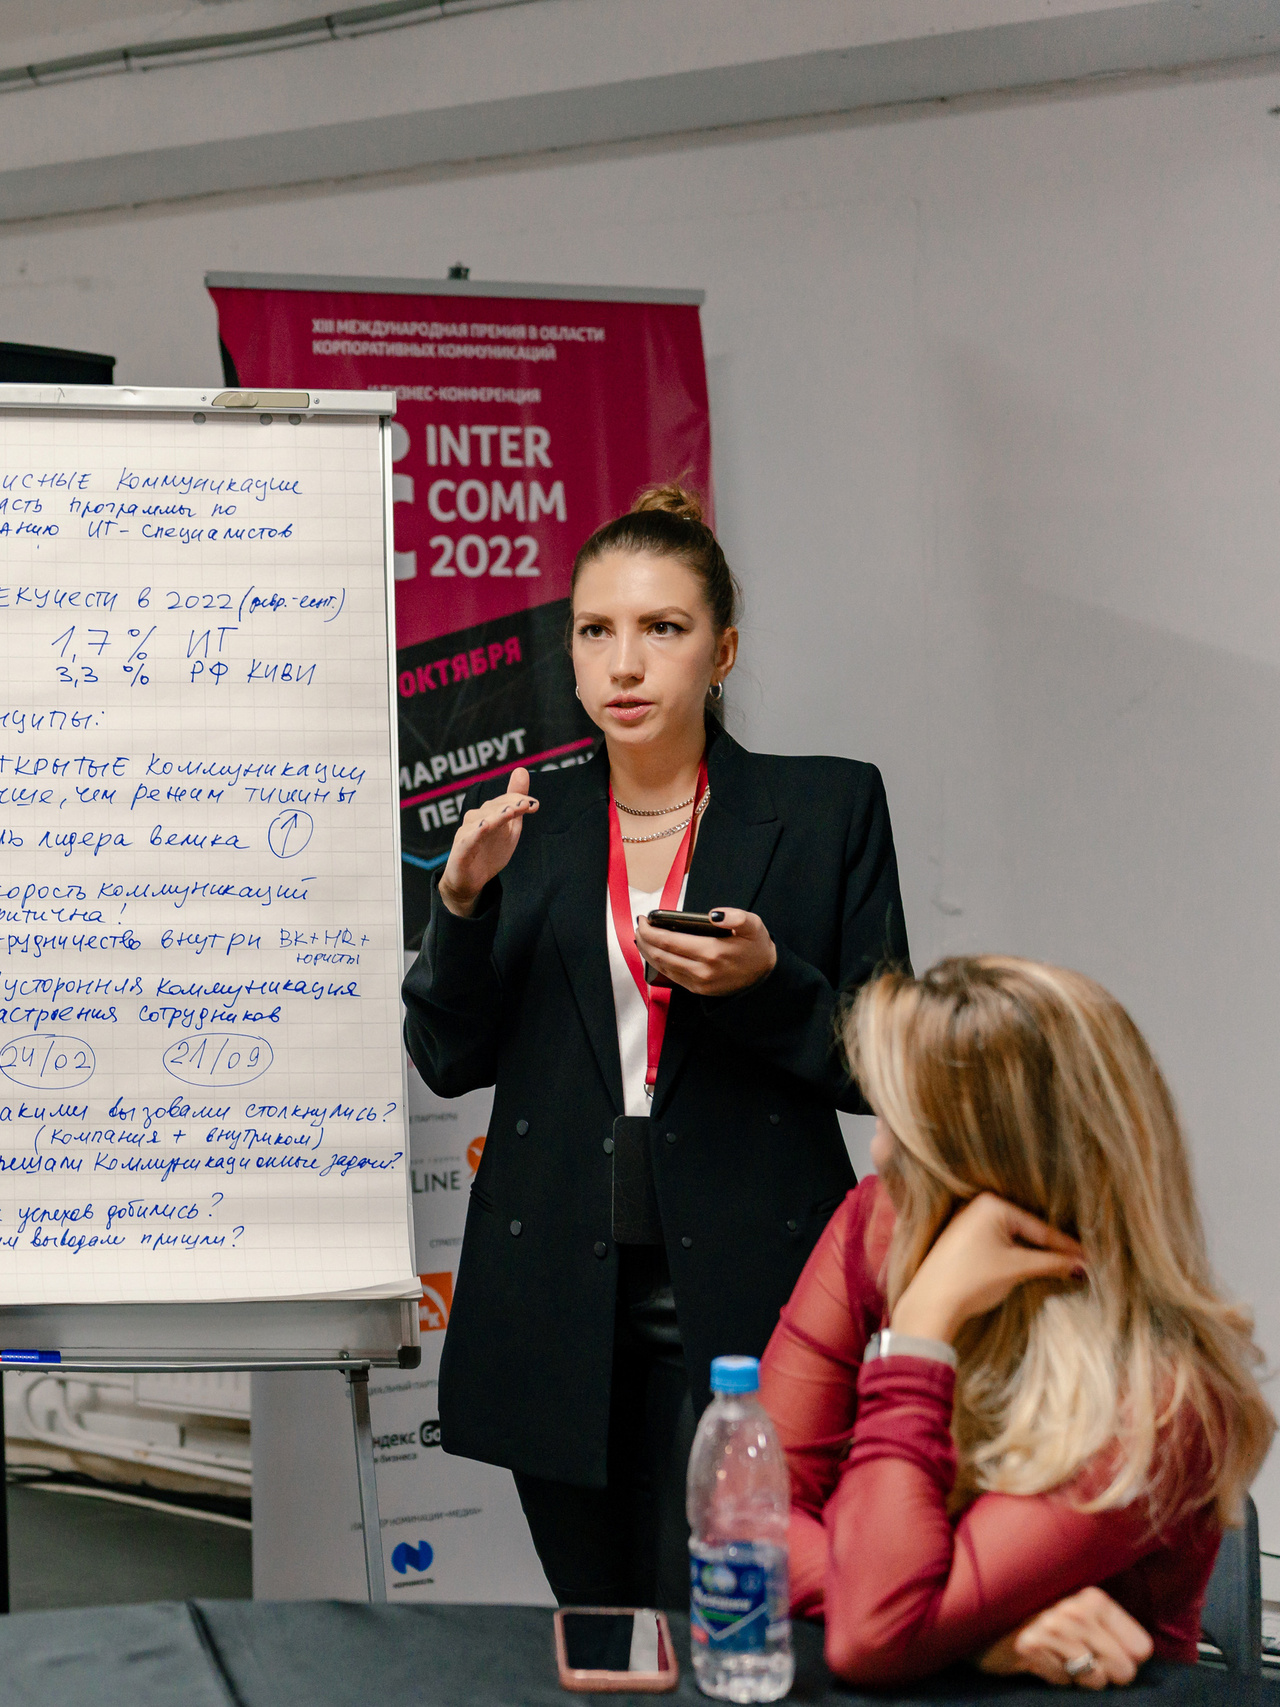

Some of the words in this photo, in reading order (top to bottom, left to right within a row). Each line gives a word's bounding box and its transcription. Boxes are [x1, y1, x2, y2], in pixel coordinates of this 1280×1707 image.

[336, 319, 468, 339] МЕЖДУНАРОДНАЯ
[470, 323, 526, 339] ПРЕМИЯ
[528, 325, 538, 340] В
[539, 326, 606, 342] ОБЛАСТИ
[312, 339, 436, 358] КОРПОРАТИВНЫХ
[437, 343, 557, 362] КОММУНИКАЦИЙ
[381, 385, 542, 404] ЗНЕС-КОНФЕРЕНЦИЯ
[426, 424, 552, 468] INTER
[211, 502, 237, 517] по
[427, 479, 568, 523] COMM
[429, 534, 541, 578] 2022
[166, 590, 234, 610] 2022
[186, 626, 239, 659] ИТ
[55, 665, 100, 688] 3,3
[190, 660, 229, 686] РФ
[247, 658, 317, 686] КИВИ
[398, 636, 523, 699] ОКТЯБРЯ
[398, 727, 527, 792] МАРШРУТ
[75, 785, 117, 805] чем
[130, 782, 225, 810] режим
[38, 830, 134, 858] лидера
[149, 824, 251, 850] велика
[161, 929, 263, 956] внутри
[296, 952, 361, 968] юристы
[108, 1096, 232, 1129] вызовами
[17, 1203, 95, 1234] успехов
[372, 1431, 417, 1451] ндекс
